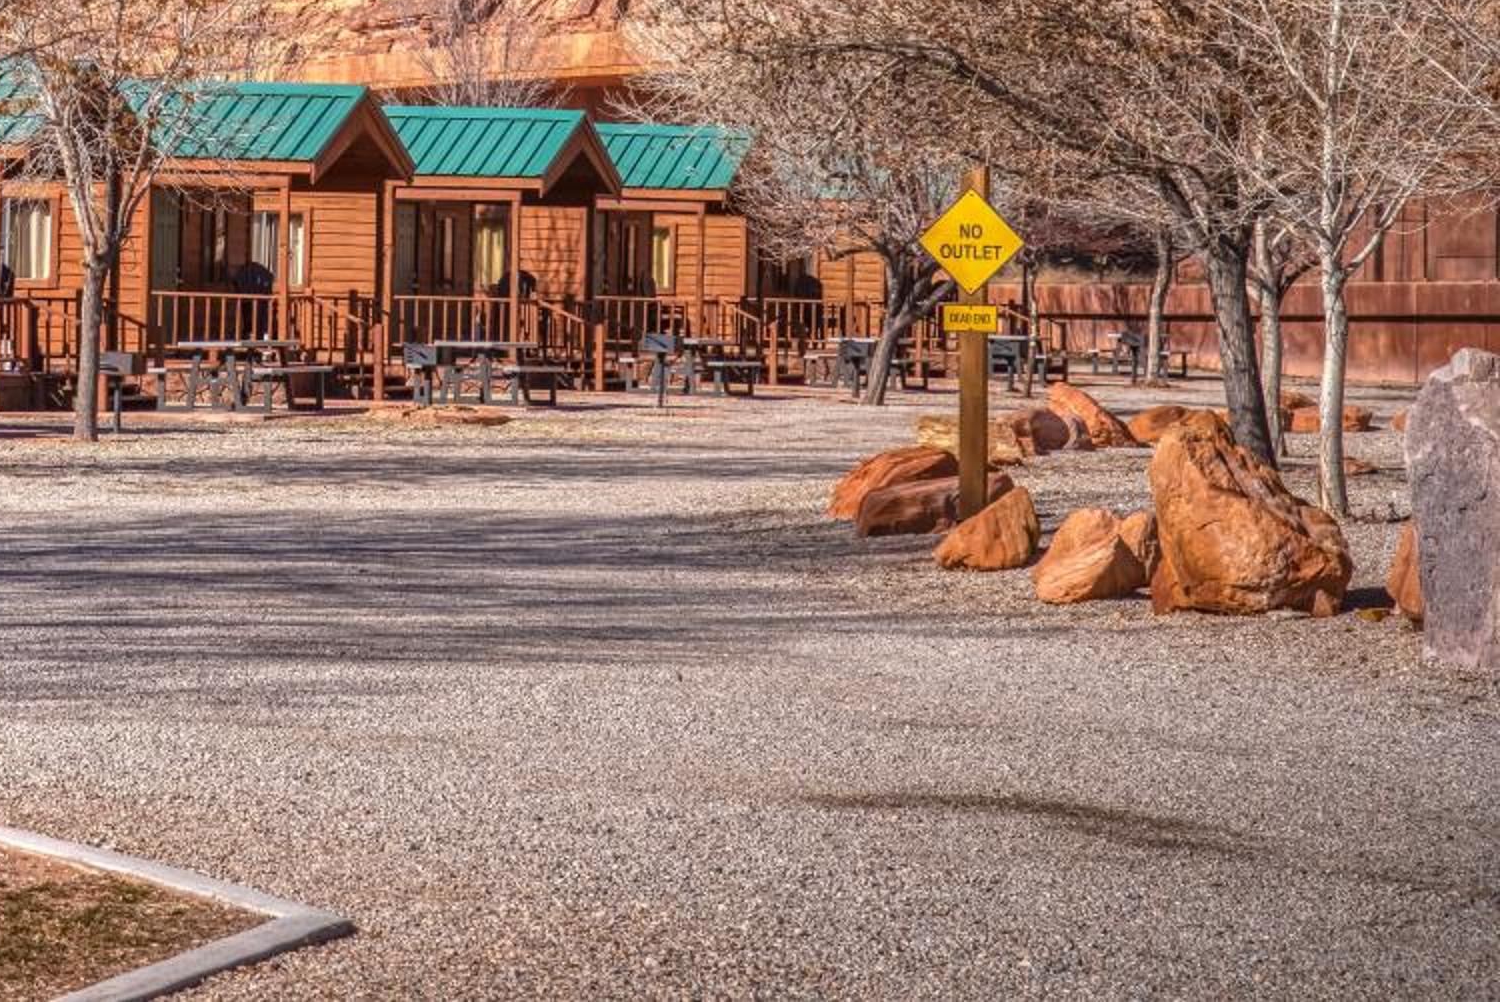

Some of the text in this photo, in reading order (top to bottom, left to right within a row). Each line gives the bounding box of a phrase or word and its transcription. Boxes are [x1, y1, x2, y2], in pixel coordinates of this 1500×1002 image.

[959, 224, 983, 239] NO
[940, 244, 1002, 260] OUTLET
[949, 313, 991, 324] DEAD END
